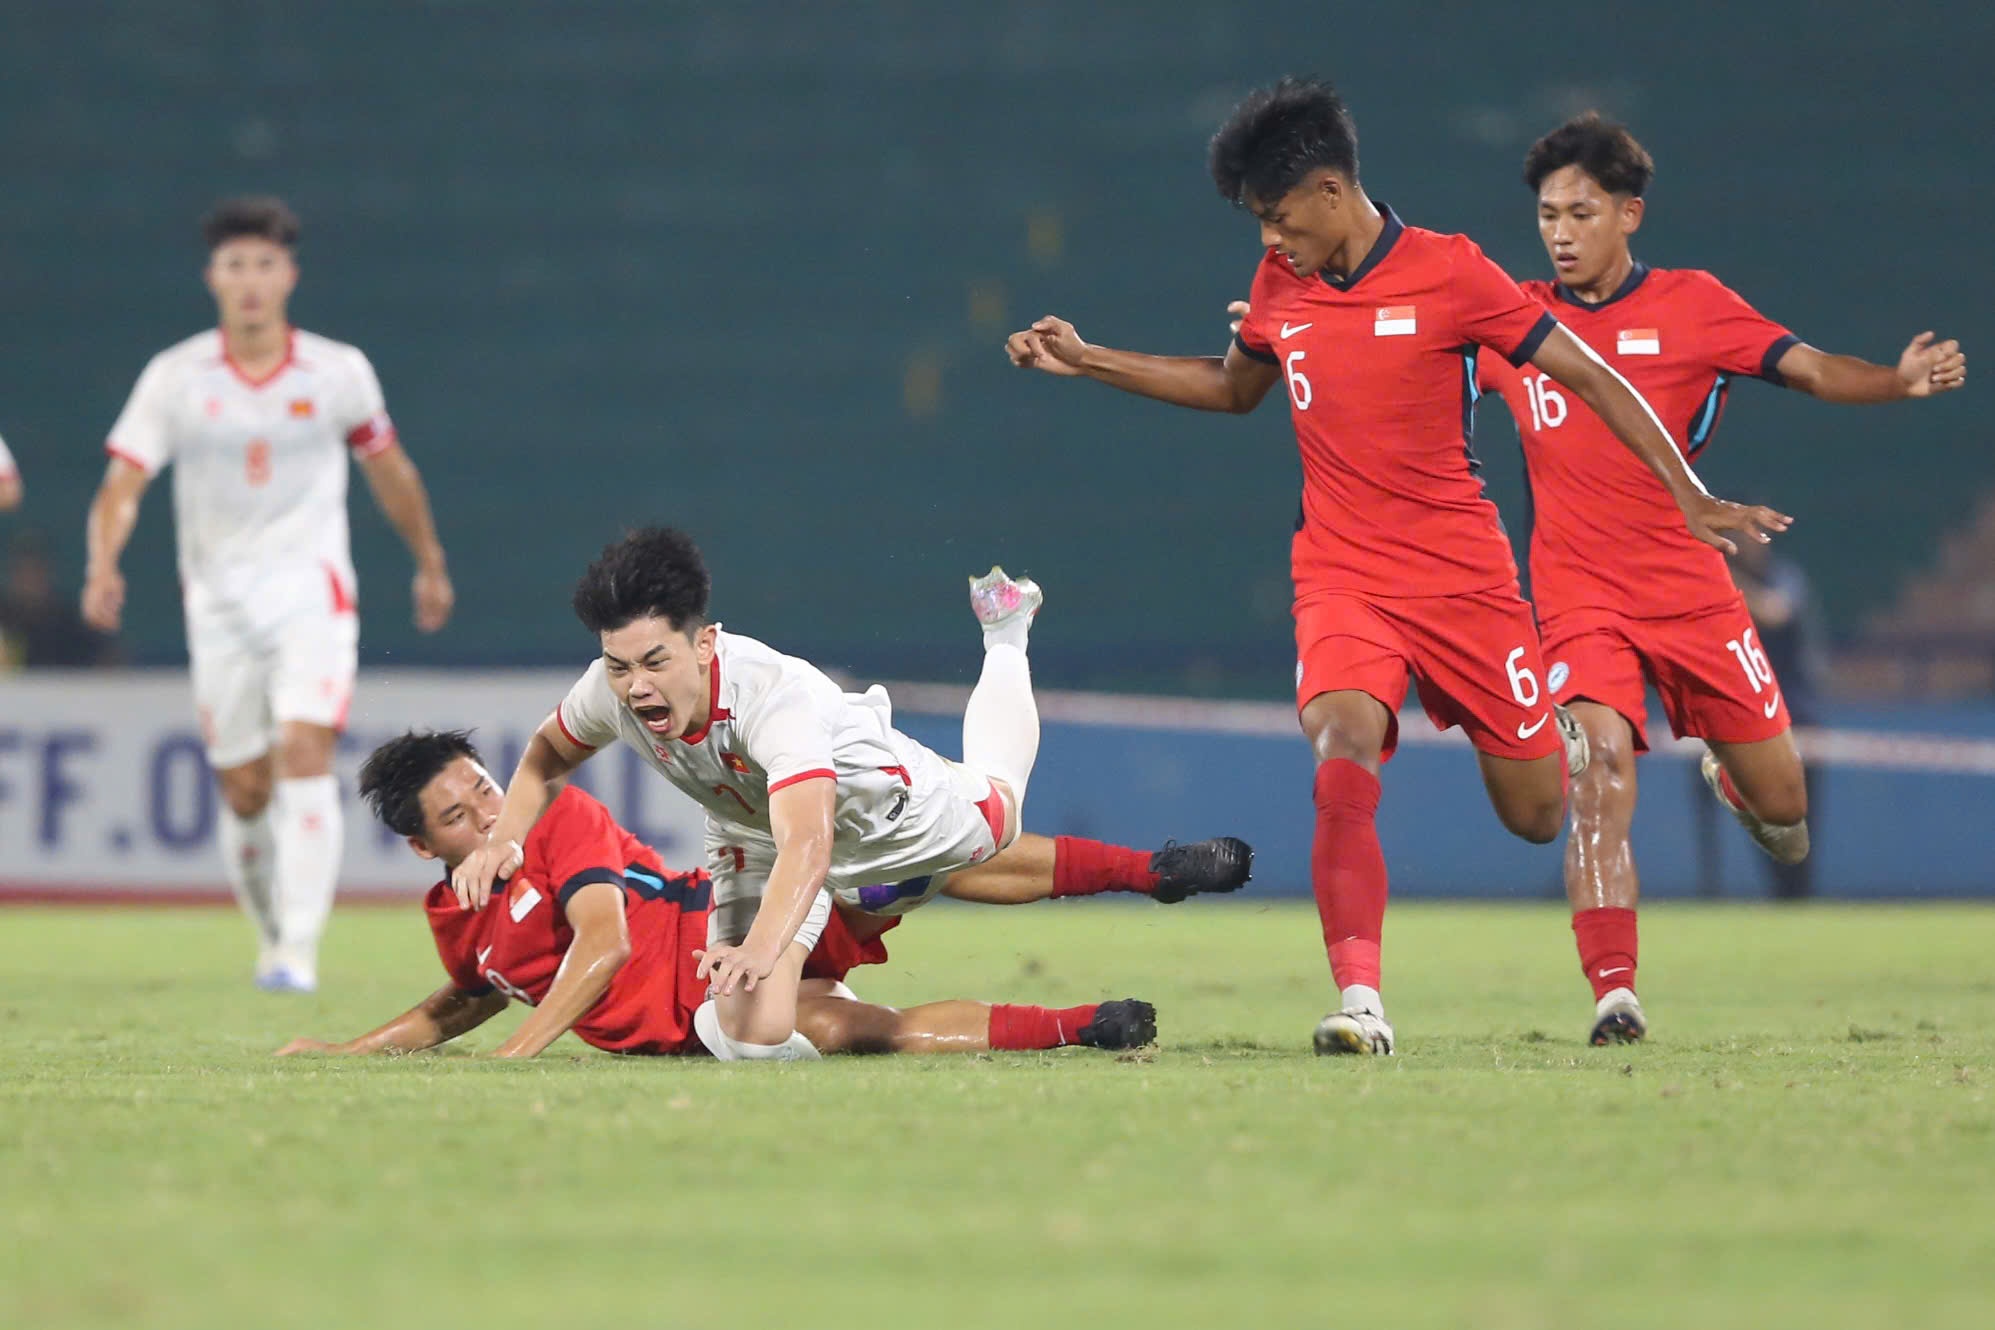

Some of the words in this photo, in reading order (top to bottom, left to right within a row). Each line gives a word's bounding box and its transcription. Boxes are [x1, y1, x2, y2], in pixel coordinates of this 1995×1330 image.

[1285, 350, 1312, 411] 6
[1522, 372, 1568, 432] 16
[1505, 646, 1539, 708] 6
[1726, 626, 1772, 694] 16
[713, 783, 756, 816] 7
